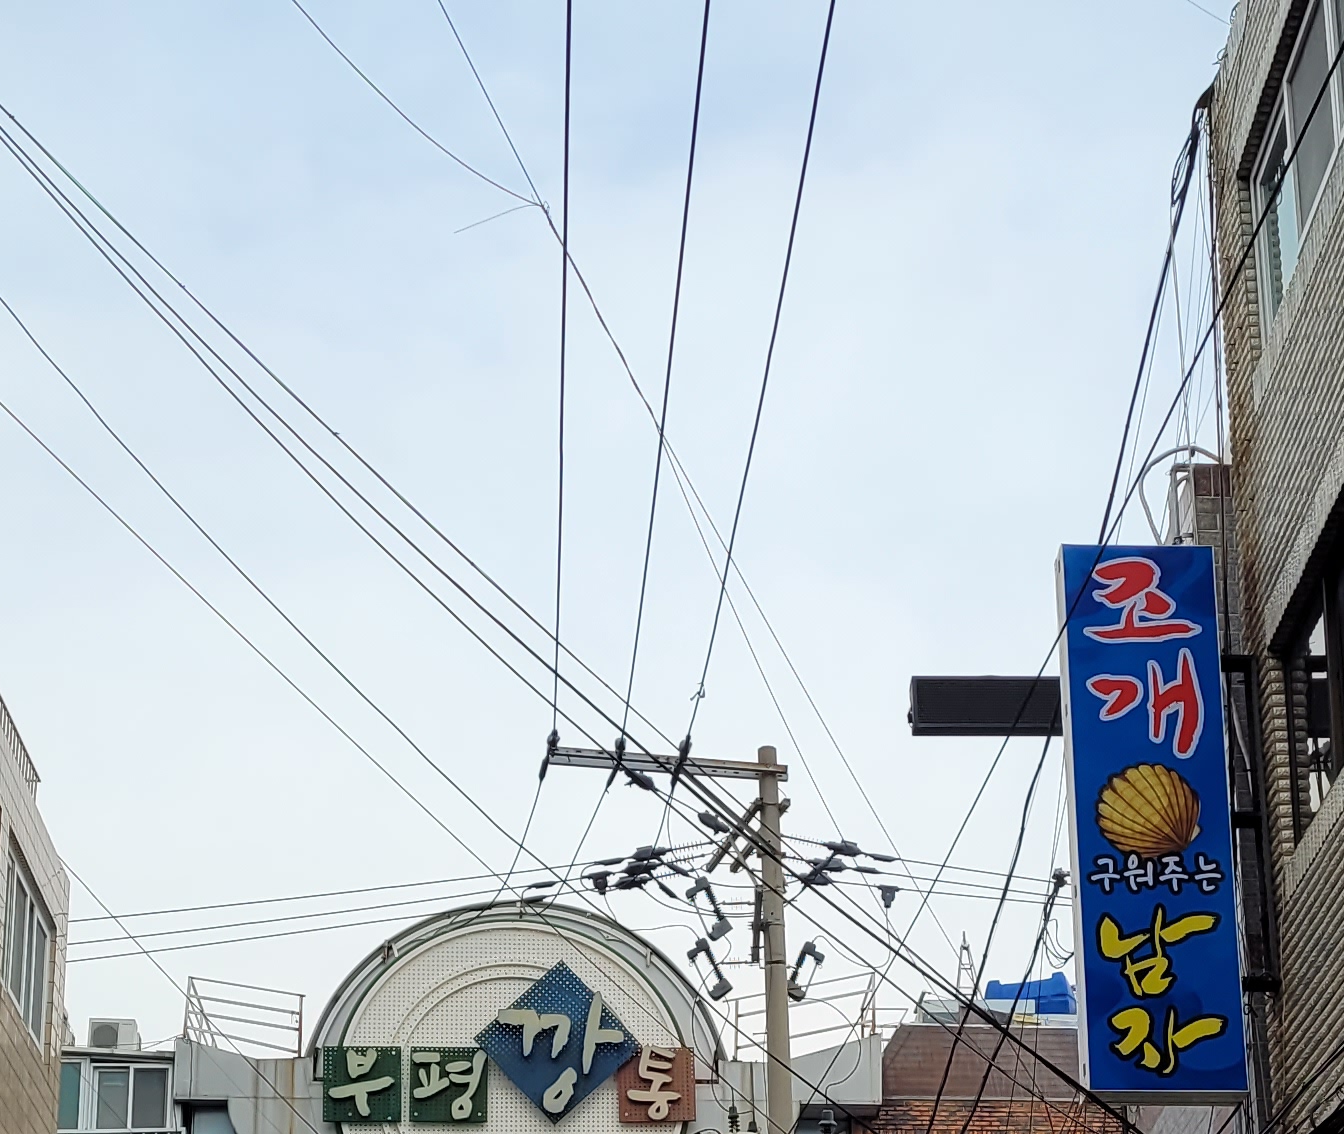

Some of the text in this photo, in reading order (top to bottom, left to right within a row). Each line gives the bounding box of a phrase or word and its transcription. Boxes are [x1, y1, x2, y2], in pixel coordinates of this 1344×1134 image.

[1084, 557, 1203, 759] 조개
[1088, 854, 1223, 895] 구워주는
[1098, 904, 1228, 1075] 남자
